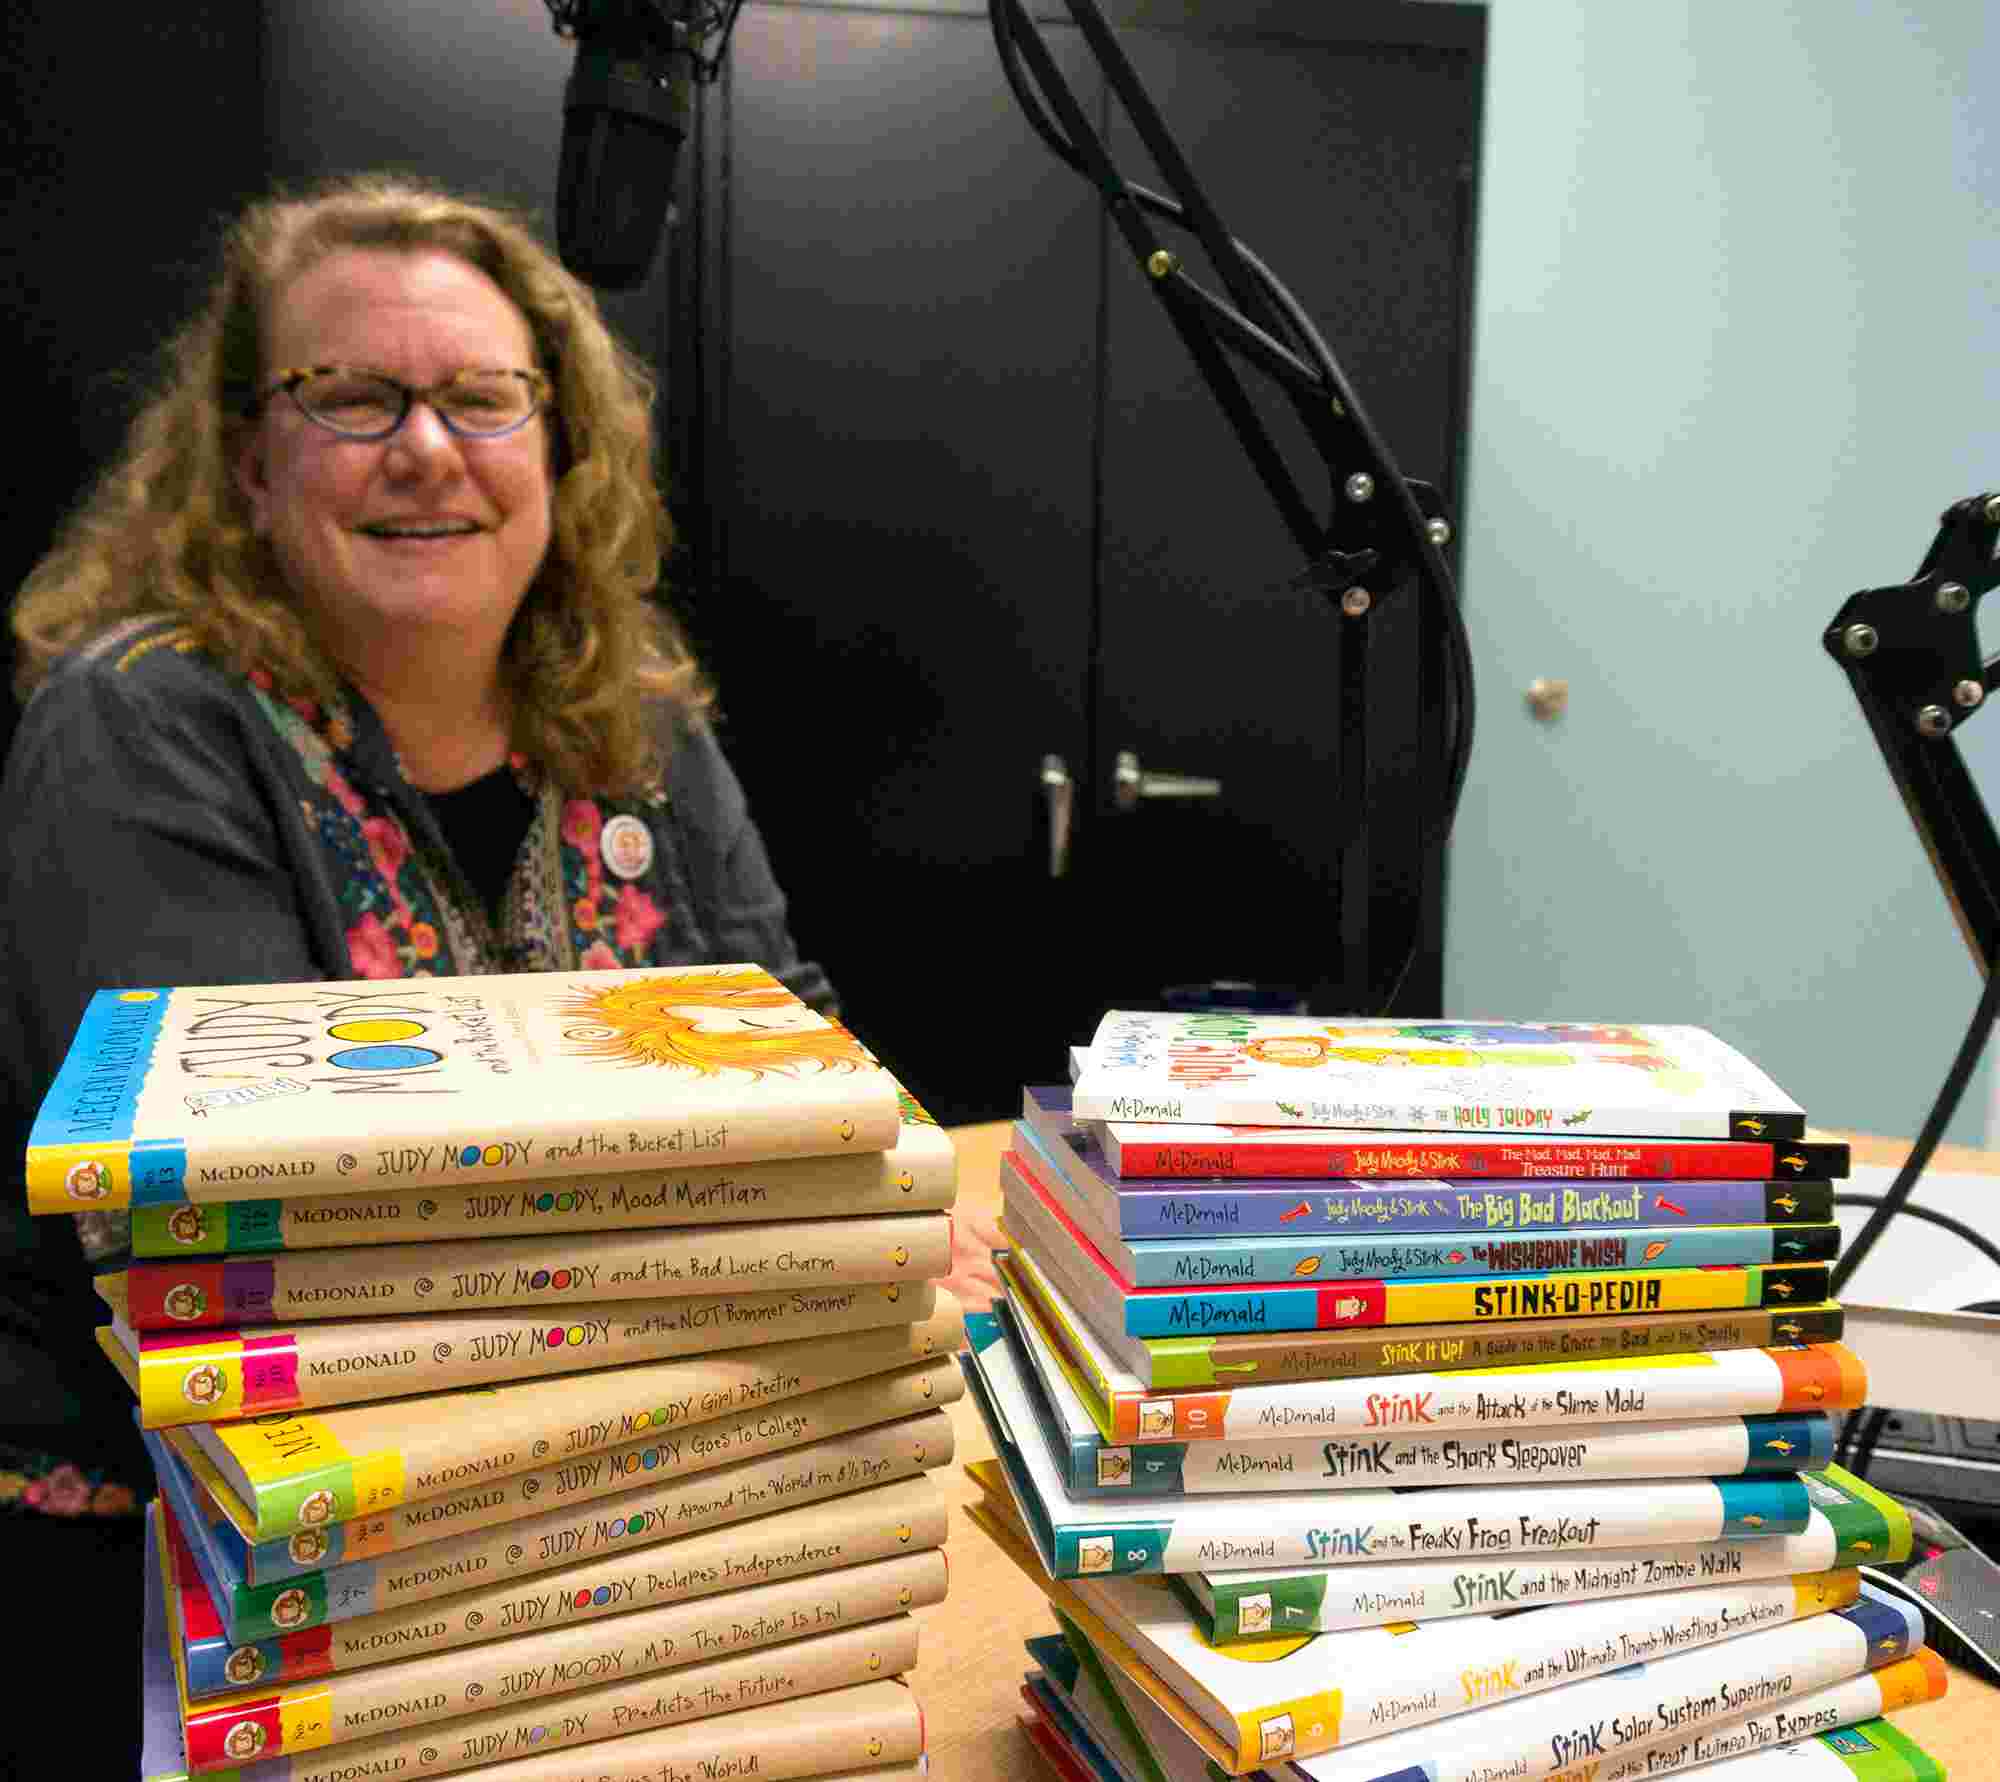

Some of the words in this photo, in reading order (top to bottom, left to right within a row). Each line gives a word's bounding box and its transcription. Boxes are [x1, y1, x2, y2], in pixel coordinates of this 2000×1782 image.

[180, 997, 318, 1074] JUDY
[311, 991, 461, 1094] MOODY
[1112, 1098, 1183, 1119] McDonald
[1454, 1104, 1490, 1128] HOLLY
[1496, 1105, 1553, 1128] JOLIDAY
[200, 1161, 316, 1184] McDONALD
[377, 1146, 434, 1177] JUDY
[441, 1138, 534, 1173] MOODY
[545, 1137, 583, 1161] and
[628, 1128, 684, 1152] Bucket
[693, 1124, 728, 1149] List
[1156, 1150, 1234, 1169] McDonald
[1352, 1151, 1379, 1174] Judy
[1381, 1150, 1424, 1175] Moody
[1429, 1150, 1461, 1170] Stink
[1501, 1148, 1523, 1161] The
[1616, 1148, 1641, 1160] Mad
[1520, 1162, 1585, 1177] Treasure
[1591, 1162, 1630, 1177] Hunt
[293, 1203, 401, 1225] McDONALD
[464, 1196, 515, 1220] JUDY
[611, 1183, 669, 1213] Mood
[675, 1176, 768, 1203] Martian
[1160, 1200, 1241, 1225] McDonald
[1351, 1199, 1393, 1224] Moody
[1399, 1197, 1430, 1216] Stink
[1456, 1194, 1484, 1219] The
[1484, 1192, 1514, 1228] Big
[1520, 1190, 1556, 1227] Bad
[1562, 1186, 1644, 1225] Blackout
[287, 1283, 395, 1305] McDONALD
[452, 1271, 506, 1299] JUDY
[513, 1264, 600, 1294] MOODY
[610, 1263, 647, 1284] and
[690, 1257, 721, 1278] Bad
[729, 1254, 768, 1274] Luck
[776, 1250, 835, 1273] Charm
[1174, 1256, 1255, 1280] McDonald
[1338, 1249, 1365, 1275] Judy
[1366, 1247, 1406, 1274] Moody
[1413, 1247, 1444, 1267] Stink
[1487, 1240, 1578, 1271] WISHBONE
[1580, 1237, 1627, 1268] WISH
[309, 1350, 417, 1376] McDONALD
[470, 1331, 521, 1361] JUDY
[529, 1319, 611, 1355] MOODY
[624, 1317, 650, 1337] and
[680, 1303, 721, 1329] NOT
[727, 1303, 787, 1323] Bummer
[791, 1288, 857, 1313] Summer
[1168, 1299, 1265, 1329] McDonald
[1474, 1279, 1662, 1316] STINK-O-PEDIA
[1380, 1342, 1422, 1367] Stink
[1426, 1341, 1437, 1361] It
[1440, 1339, 1465, 1362] Up!
[415, 1451, 515, 1490] McDONALD
[566, 1419, 614, 1452] JUDY
[619, 1396, 693, 1441] MOODY
[700, 1388, 733, 1412] Girl
[740, 1371, 801, 1403] Detective
[1187, 1408, 1209, 1431] 10
[1257, 1400, 1336, 1427] McDonald
[1361, 1392, 1438, 1427] Stink
[1476, 1392, 1527, 1420] Attack
[1557, 1390, 1600, 1416] Slime
[1604, 1387, 1645, 1415] Mold
[405, 1490, 505, 1528] McDONALD
[556, 1461, 603, 1495] JUDY
[609, 1439, 681, 1481] MOODY
[691, 1432, 730, 1457] Goes
[735, 1421, 753, 1445] to
[757, 1413, 809, 1438] College
[1216, 1453, 1294, 1476] McDonald
[1322, 1441, 1395, 1477] Stink
[1395, 1449, 1416, 1466] and
[1422, 1447, 1440, 1465] the
[1443, 1440, 1497, 1471] Shark
[1501, 1438, 1587, 1472] Sleepover
[388, 1556, 489, 1594] McDONALD
[539, 1526, 587, 1560] JUDY
[594, 1505, 668, 1548] MOODY
[677, 1492, 734, 1521] Around
[769, 1475, 813, 1496] World
[817, 1470, 833, 1486] in
[863, 1457, 891, 1481] Days
[1127, 1548, 1148, 1561] 8
[1199, 1539, 1275, 1561] McDonald
[1303, 1526, 1377, 1561] Stink
[1408, 1523, 1463, 1552] Freaky
[1467, 1517, 1512, 1550] Frog
[1519, 1515, 1601, 1549] Freakout
[344, 1622, 448, 1654] McDONALD
[501, 1593, 551, 1627] JUDY
[557, 1577, 637, 1617] MOODY
[648, 1567, 719, 1592] Declares
[724, 1543, 841, 1577] Independence
[1352, 1590, 1425, 1615] McDonald
[1451, 1568, 1518, 1609] Stink
[1521, 1576, 1545, 1596] and
[1550, 1574, 1569, 1592] the
[1575, 1560, 1638, 1593] Midnight
[1642, 1559, 1696, 1584] Zombie
[1700, 1550, 1742, 1575] Walk
[344, 1693, 448, 1728] McDONALD
[500, 1663, 546, 1697] JUDY
[551, 1649, 624, 1686] MOODY
[731, 1617, 785, 1643] Doctor
[1368, 1689, 1440, 1726] McDonald
[1458, 1660, 1520, 1705] Stink
[1524, 1666, 1544, 1687] and
[1564, 1645, 1617, 1674] Ultimate
[1619, 1617, 1718, 1660] Thumb-Wrestling
[1721, 1601, 1785, 1632] Smackdown
[462, 1730, 508, 1760] JUDY
[612, 1693, 694, 1727] Predicts
[738, 1673, 795, 1698] Future
[1550, 1720, 1606, 1770] Stink
[1612, 1717, 1654, 1746] Solar
[1657, 1694, 1717, 1731] System
[1721, 1673, 1792, 1711] Superhero
[1694, 1735, 1746, 1763] Guinea
[1775, 1706, 1839, 1741] Express
